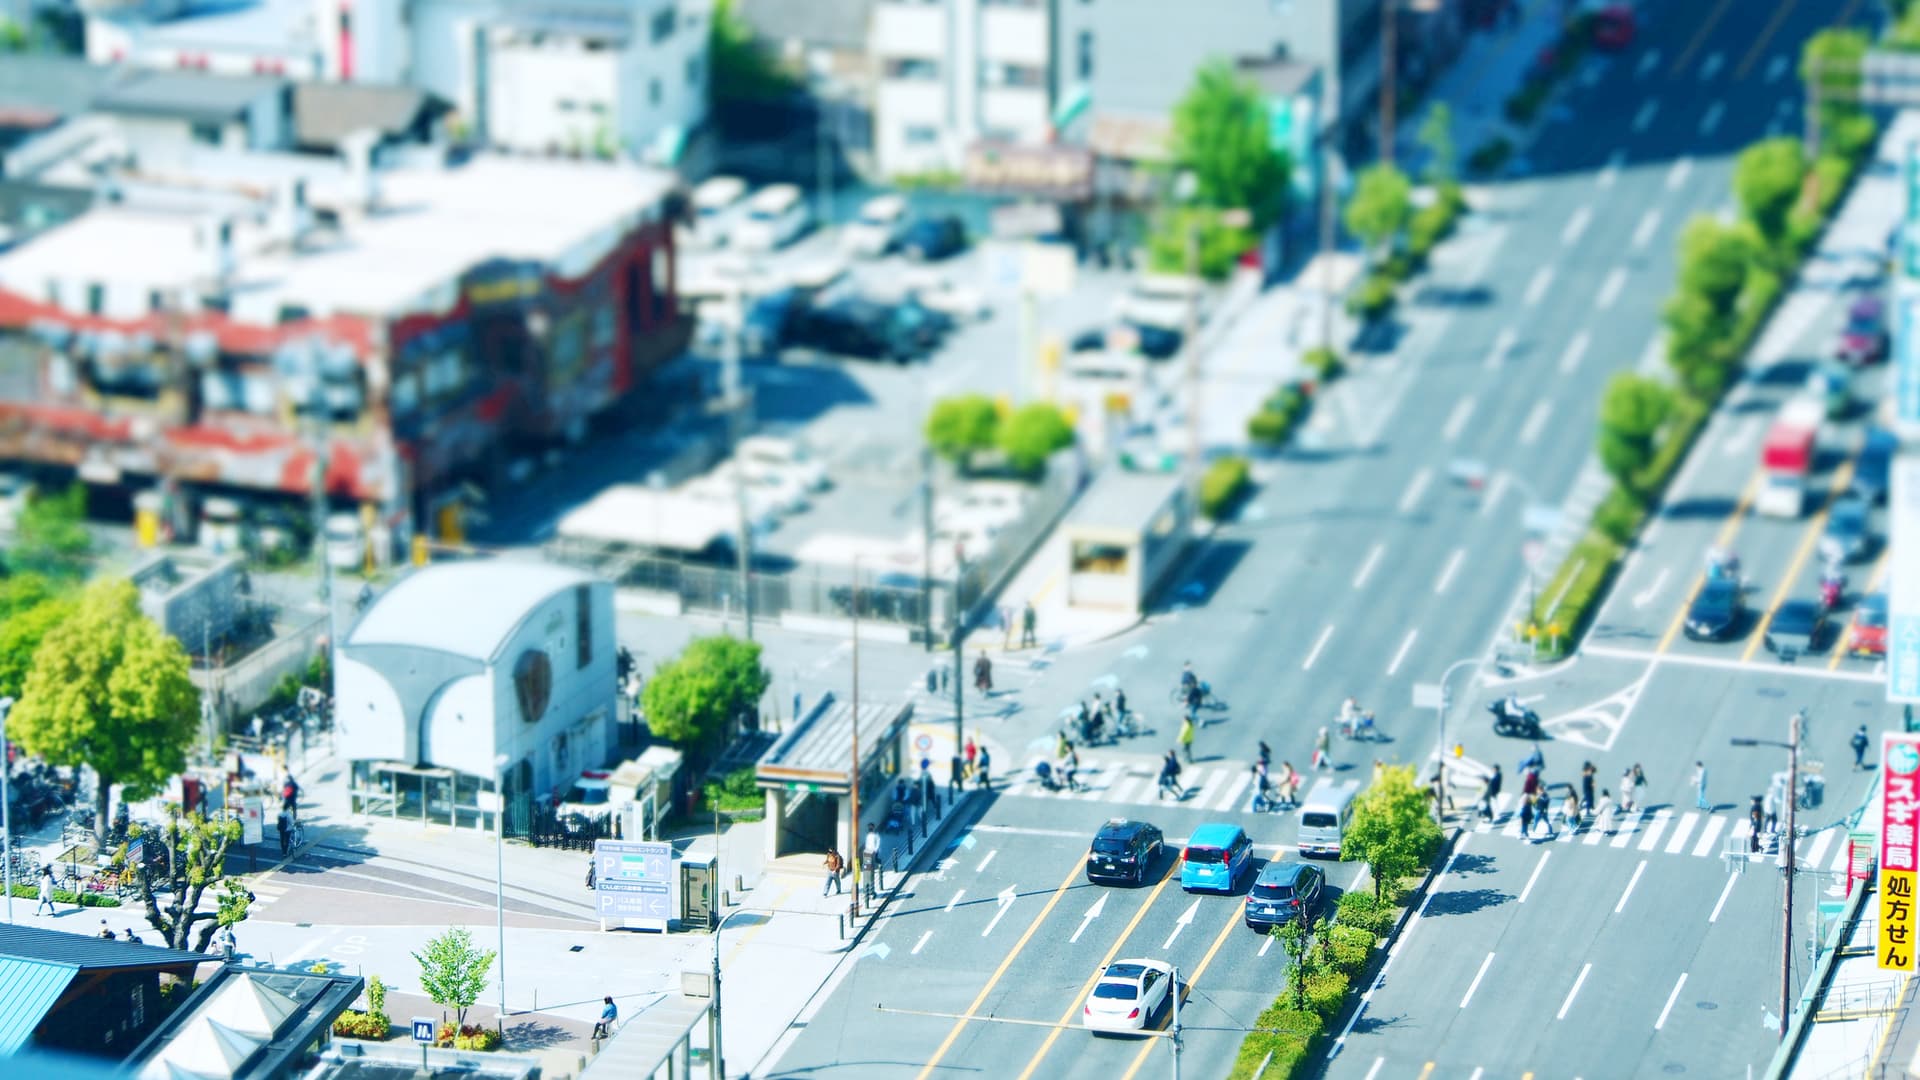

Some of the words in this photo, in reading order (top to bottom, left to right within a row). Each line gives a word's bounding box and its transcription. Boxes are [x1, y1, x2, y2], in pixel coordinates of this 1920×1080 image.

[1886, 778, 1920, 869] スギ薬局
[604, 858, 615, 872] P
[602, 896, 613, 911] P
[1886, 876, 1911, 967] 処方せん
